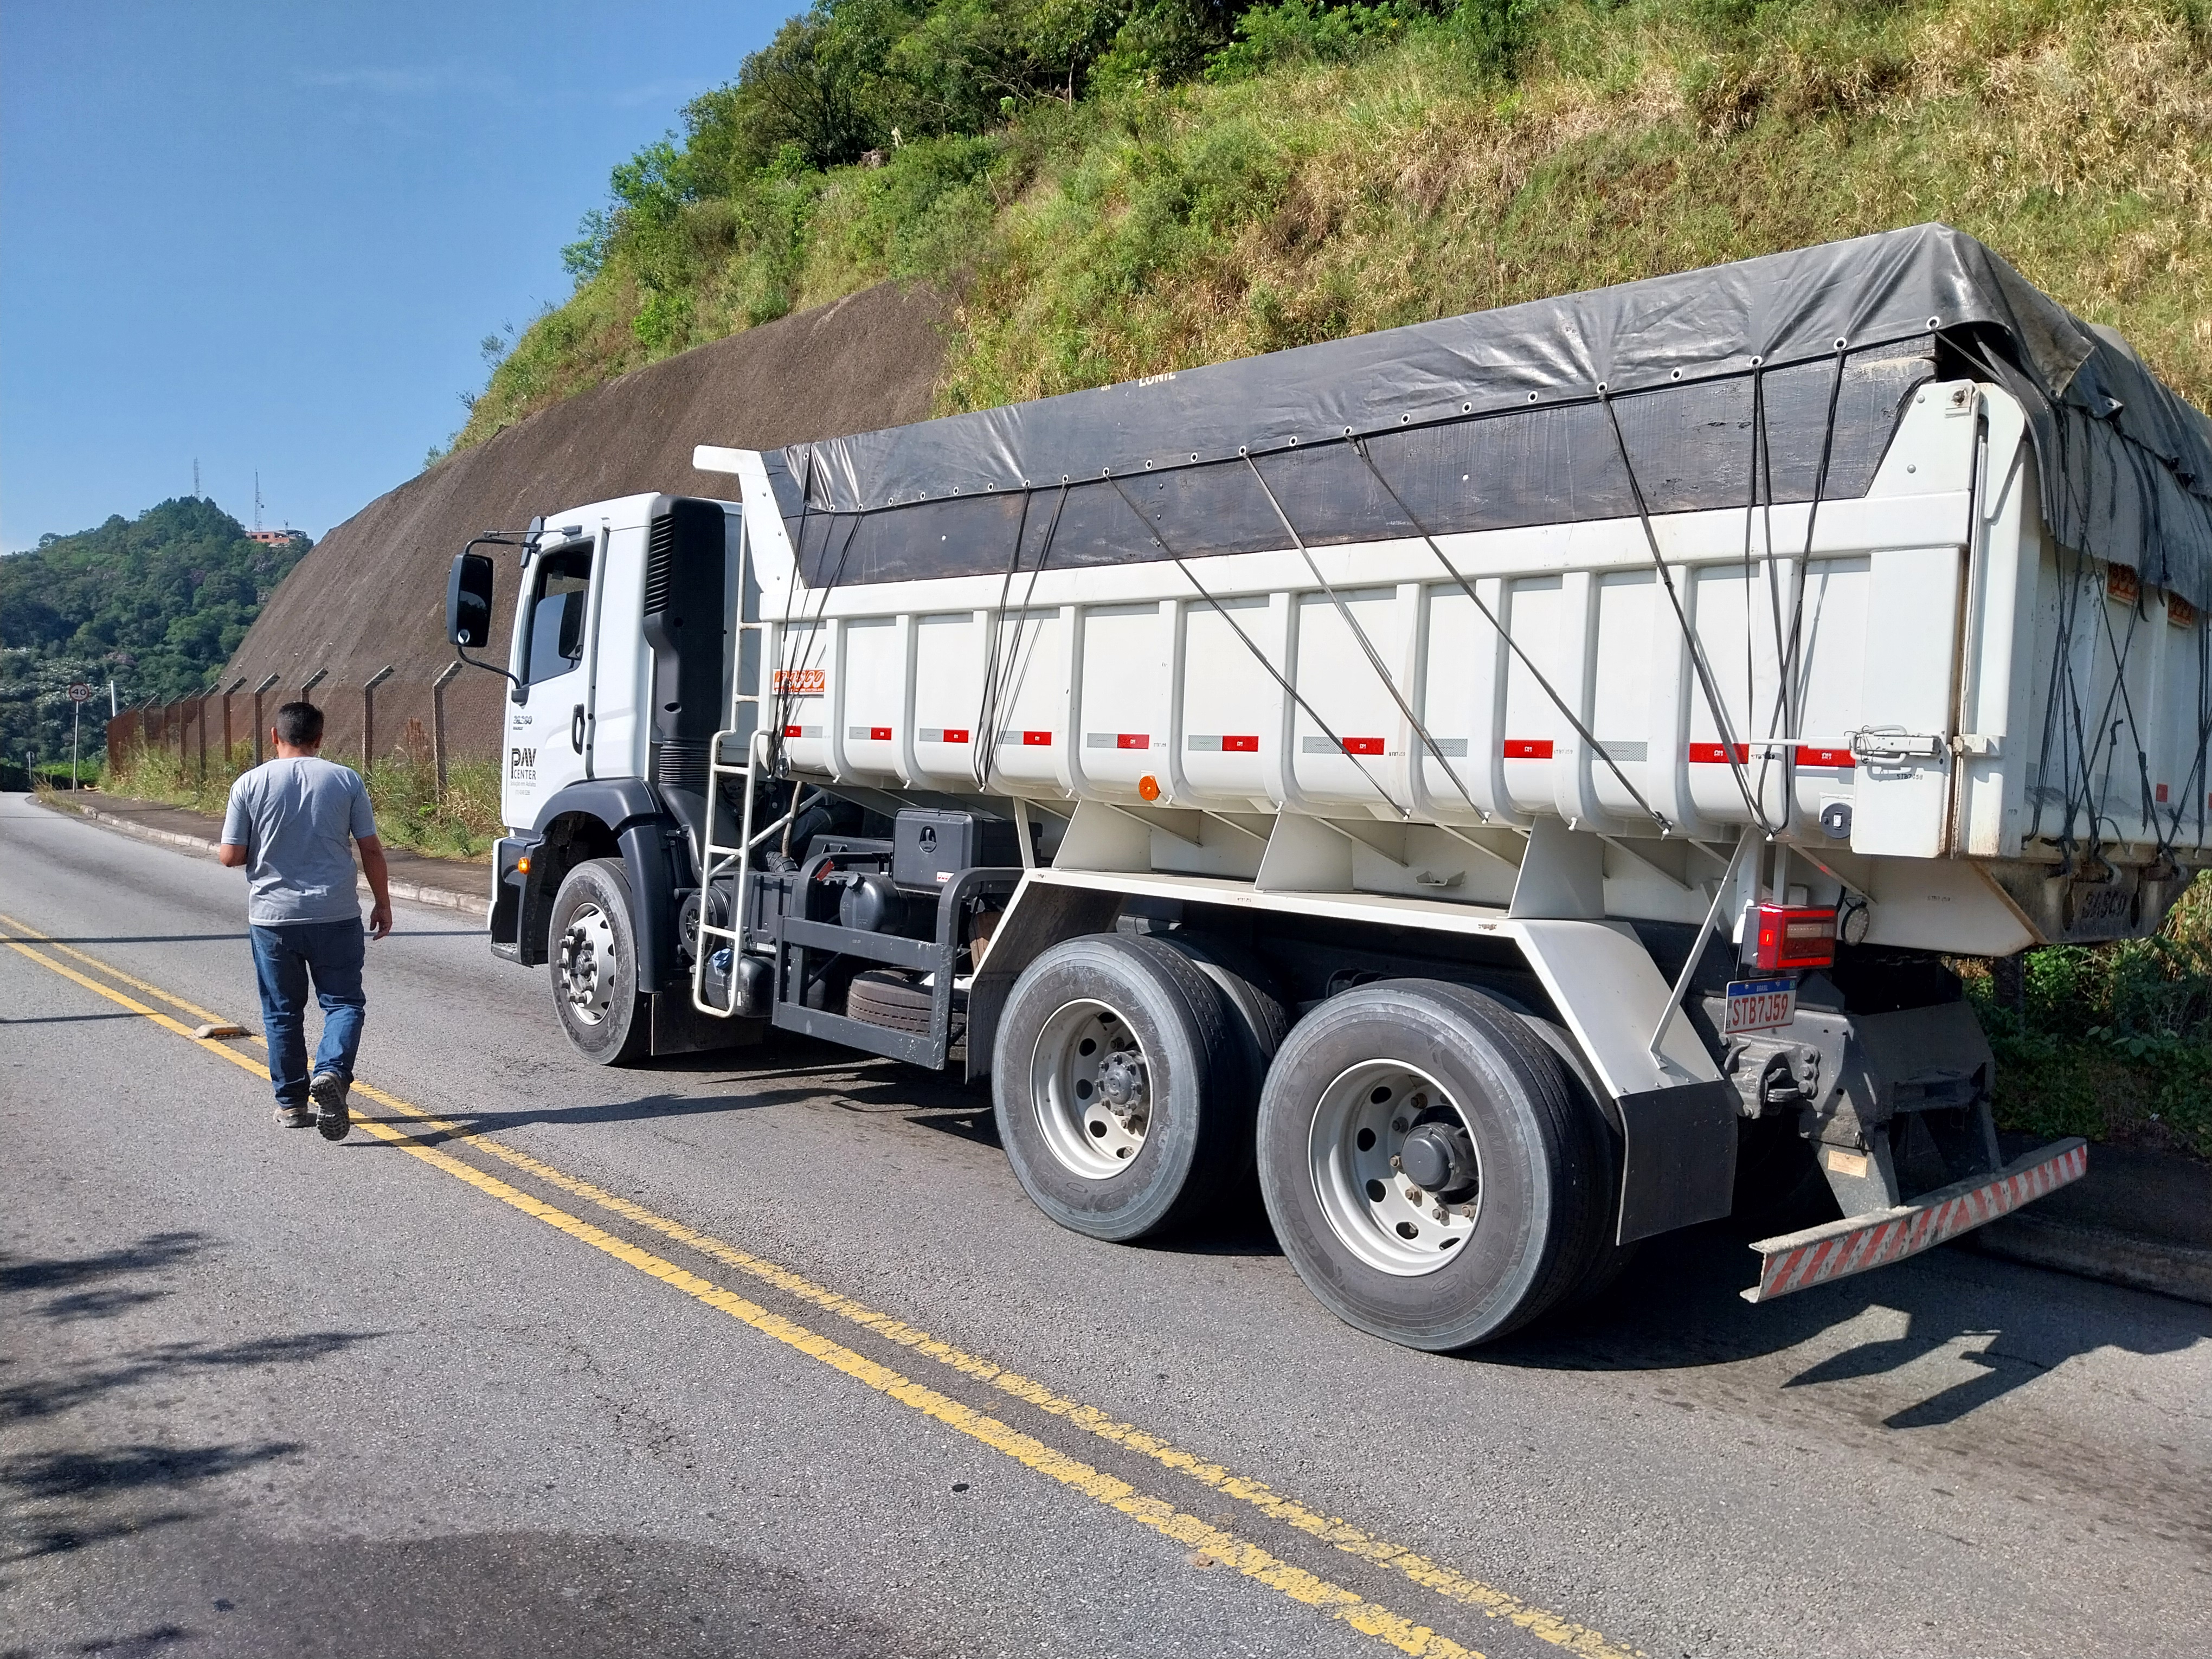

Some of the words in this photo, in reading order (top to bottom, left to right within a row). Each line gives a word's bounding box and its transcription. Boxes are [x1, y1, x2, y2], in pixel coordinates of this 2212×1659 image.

[511, 748, 537, 779] PAV
[513, 769, 536, 780] CENTER
[1732, 993, 1789, 1026] STB7J59
